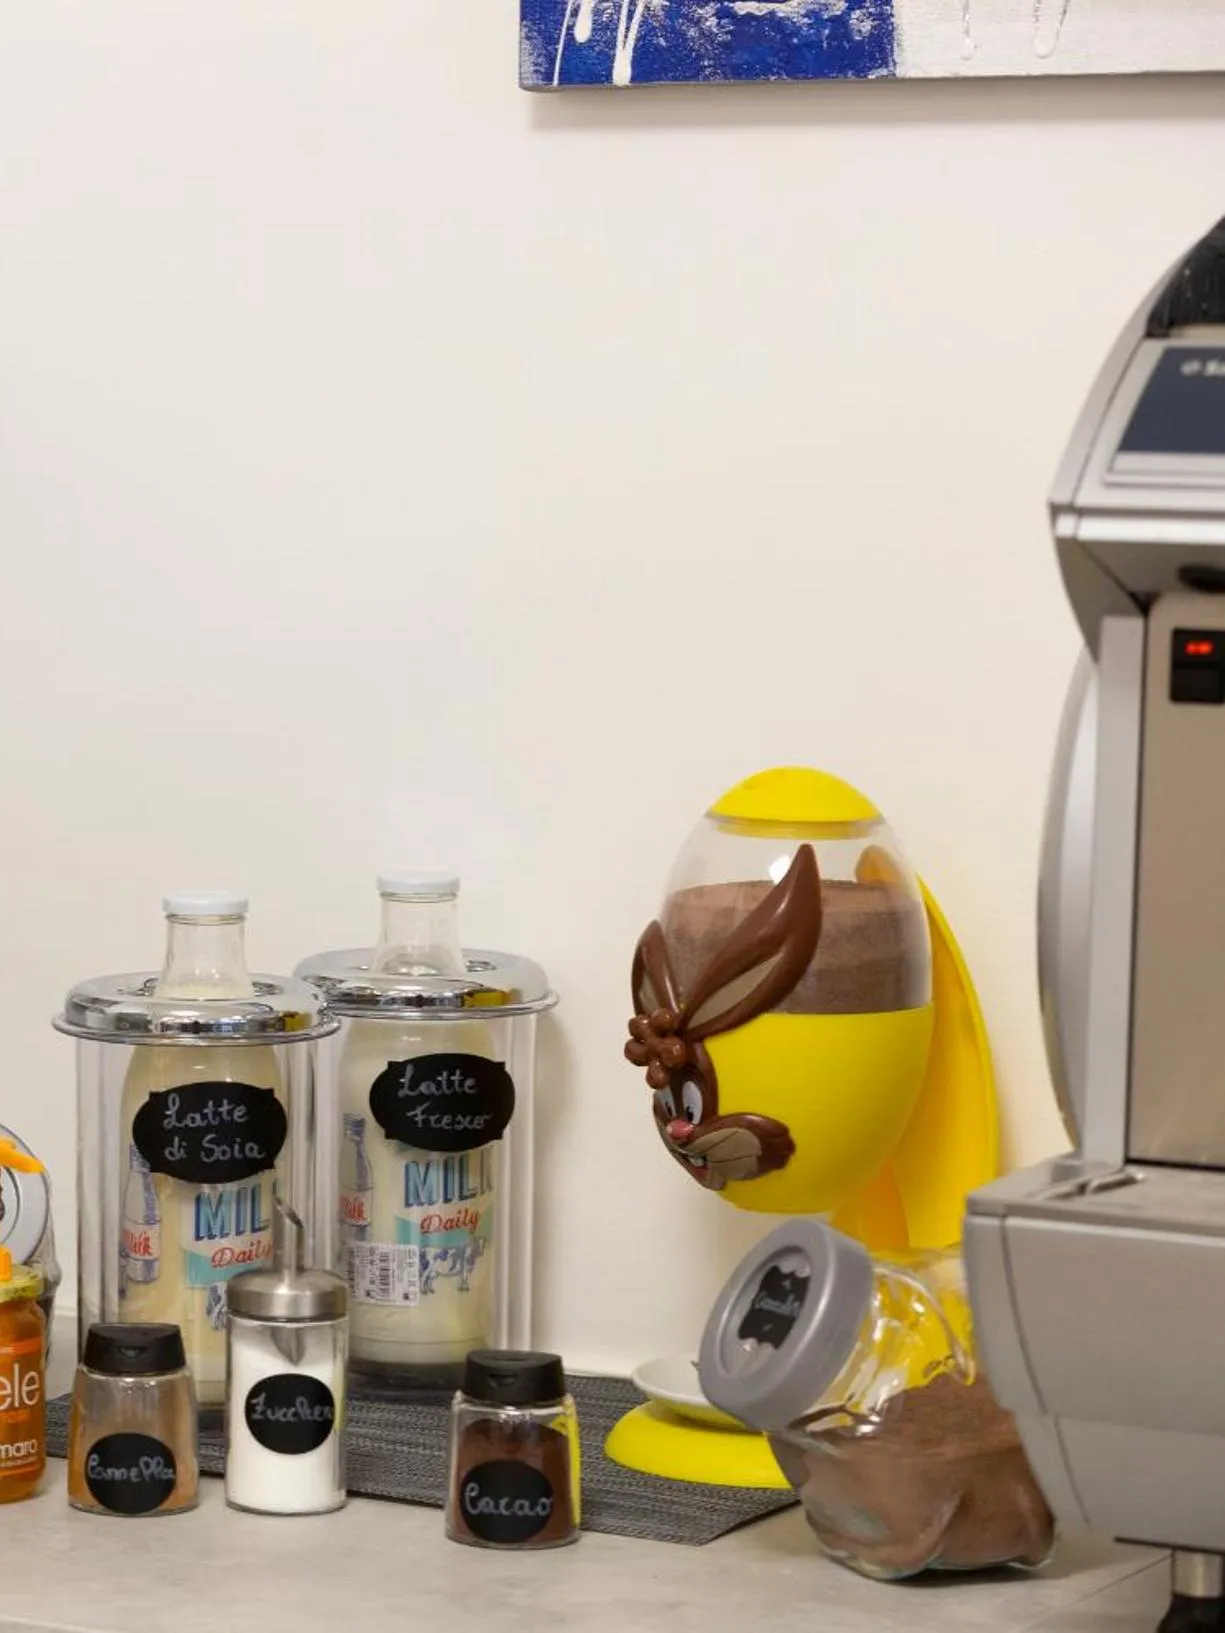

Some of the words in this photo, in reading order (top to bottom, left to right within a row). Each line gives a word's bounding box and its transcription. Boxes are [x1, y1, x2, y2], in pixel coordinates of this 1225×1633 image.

[396, 1063, 478, 1097] Latte
[162, 1094, 250, 1130] Latte
[164, 1136, 188, 1162] di
[200, 1133, 267, 1163] Soia
[419, 1207, 480, 1234] Daily
[464, 1482, 551, 1516] Cacao
